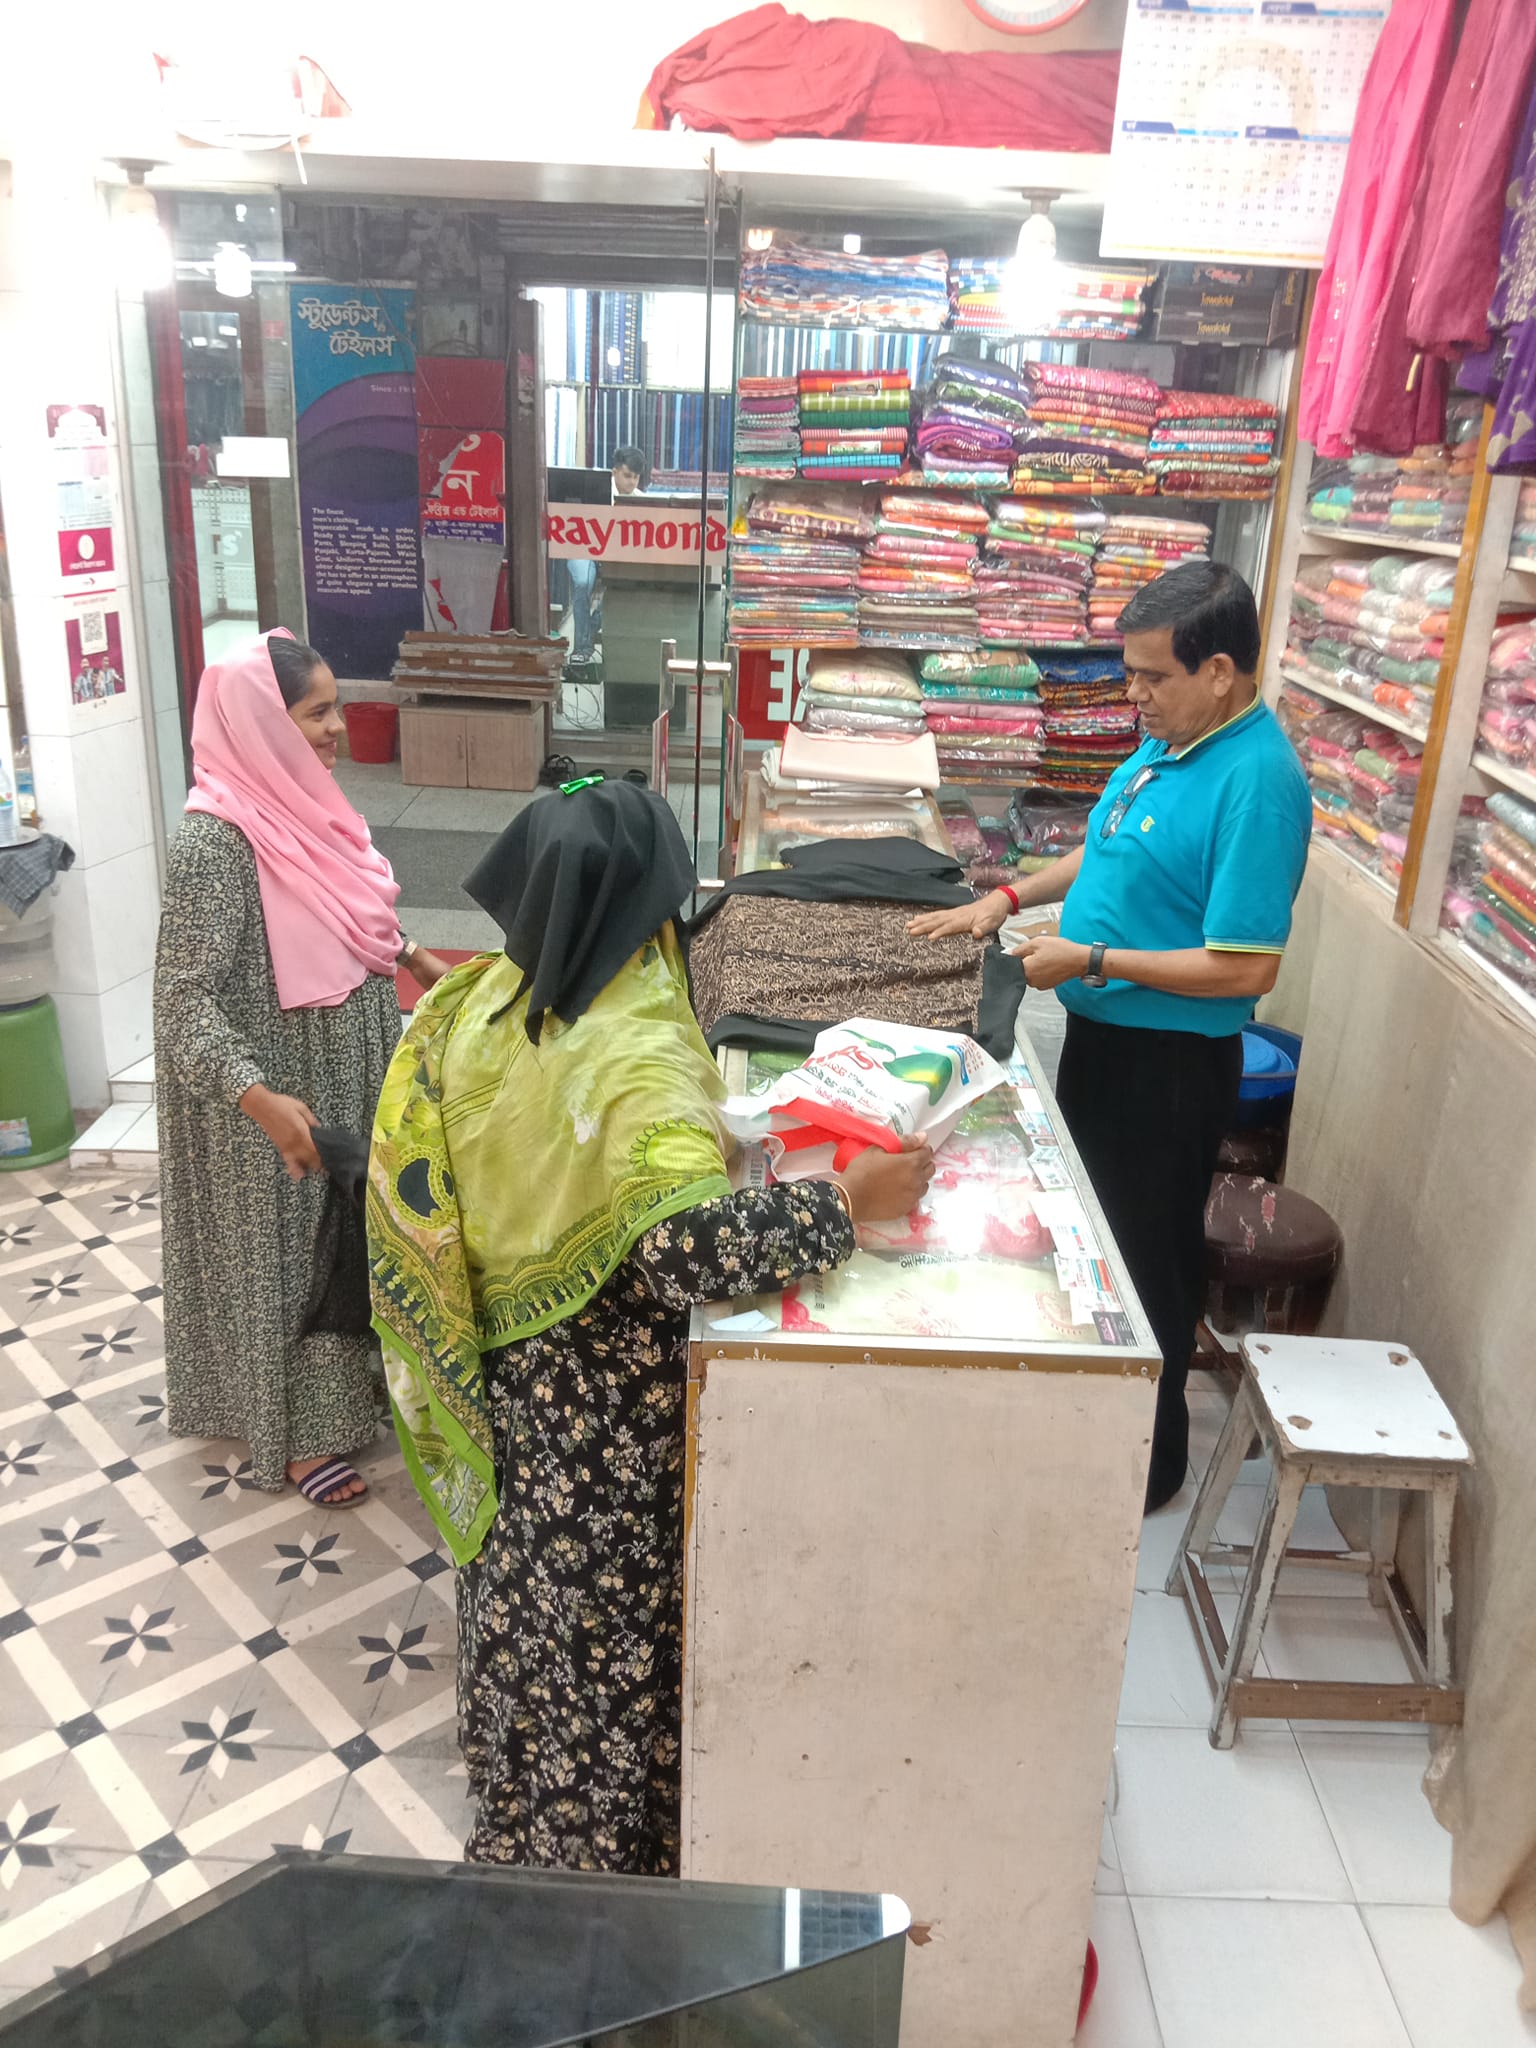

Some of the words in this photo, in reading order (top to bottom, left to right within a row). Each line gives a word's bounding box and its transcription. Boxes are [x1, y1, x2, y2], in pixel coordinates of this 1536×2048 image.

[333, 517, 359, 525] clothing
[313, 531, 333, 539] Ready
[547, 515, 727, 556] Raymond
